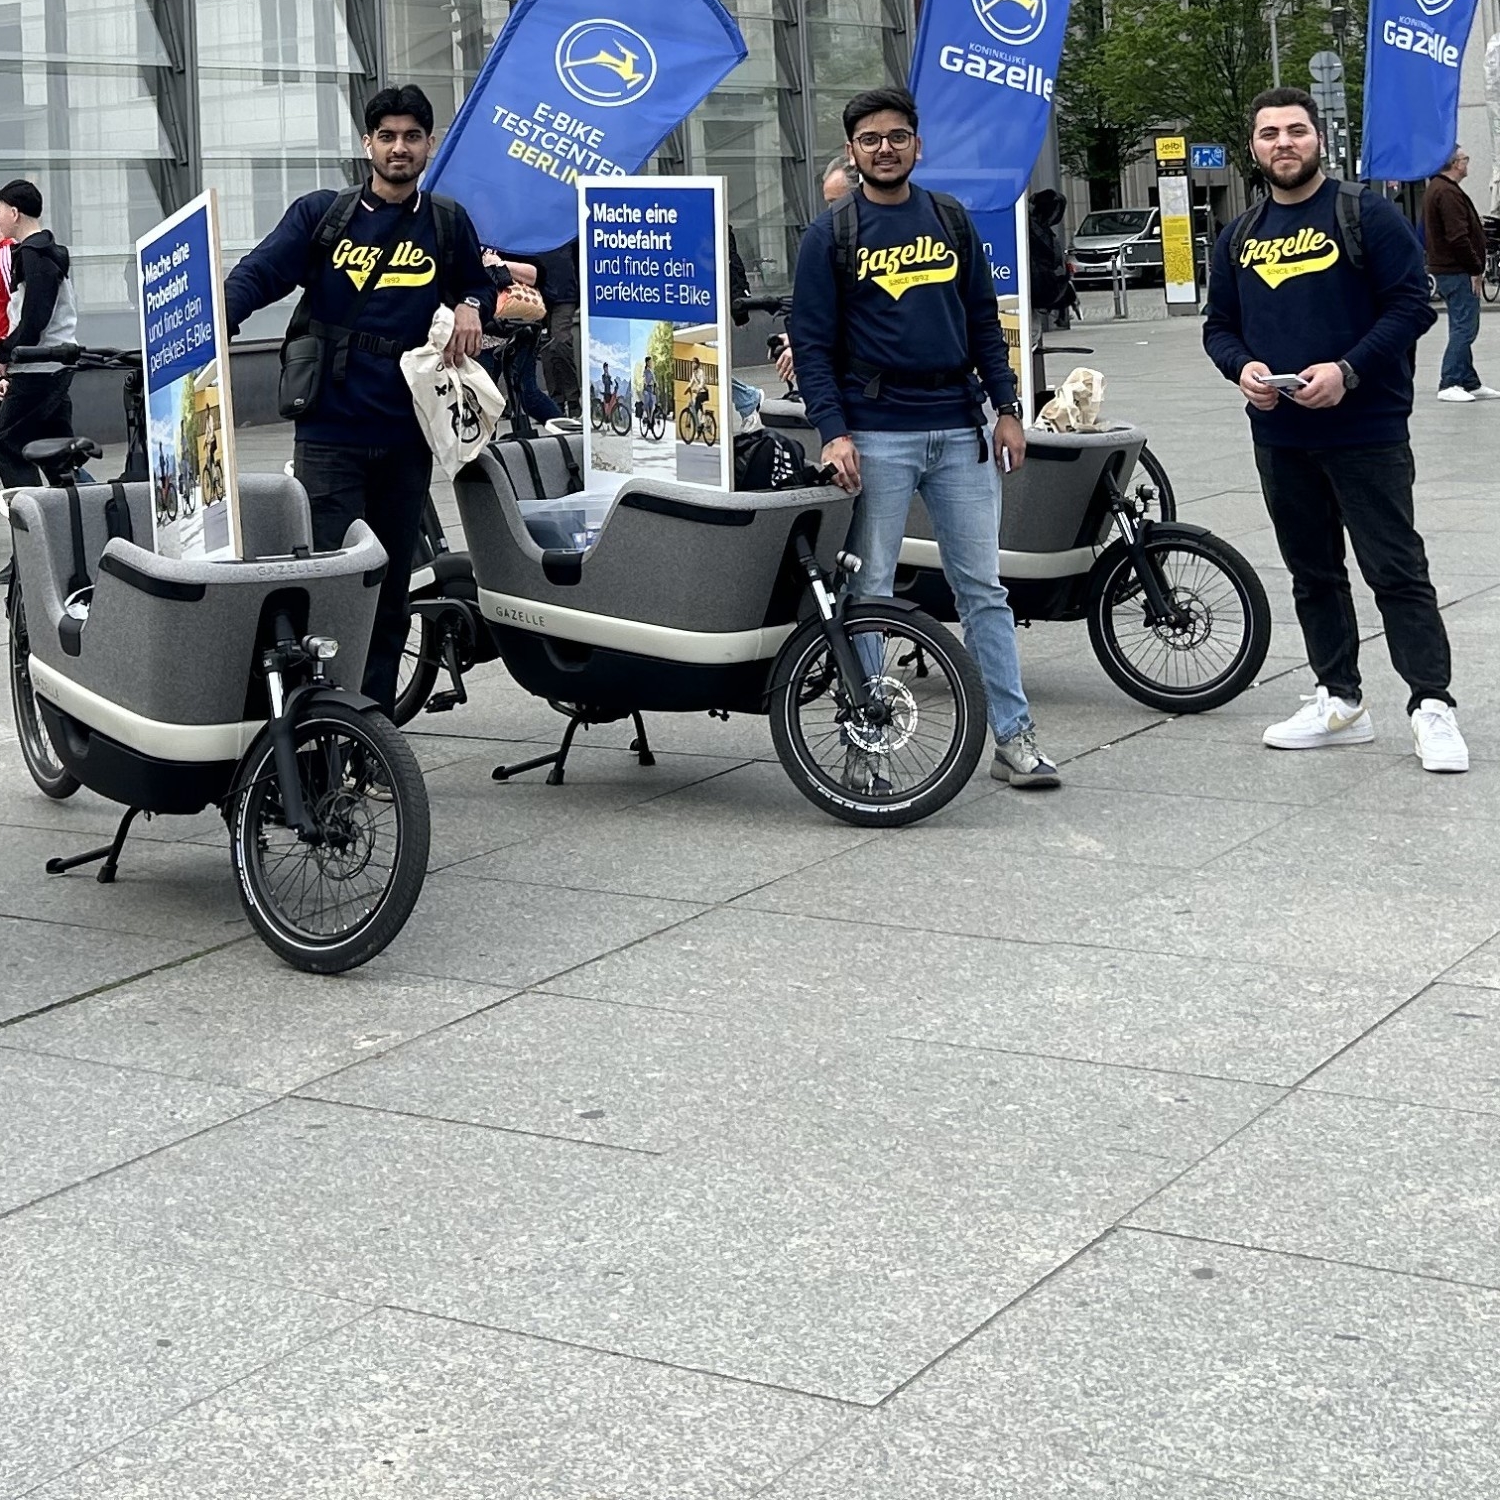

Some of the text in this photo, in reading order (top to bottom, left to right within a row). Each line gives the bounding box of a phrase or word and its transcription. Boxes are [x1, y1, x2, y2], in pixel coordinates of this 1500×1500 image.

[1384, 20, 1459, 68] Gazelle
[940, 45, 1053, 102] Gazelle
[491, 106, 627, 177] TESTCENTER
[533, 102, 605, 149] E-BIKE
[593, 203, 678, 224] Mache eine
[332, 239, 424, 272] Gazlle
[594, 229, 672, 250] Probefahrt
[857, 236, 946, 281] Gazelle
[1240, 228, 1326, 268] Gazelle
[145, 242, 190, 286] Mache eine
[595, 256, 695, 278] und finde dein
[146, 271, 189, 315] Probefahrt
[595, 282, 711, 306] perfektes E-Bike
[149, 295, 202, 344] und finde dein
[150, 321, 212, 378] perfektes E-Bike
[258, 561, 323, 576] GAZELLE
[495, 606, 546, 628] GAZELLE
